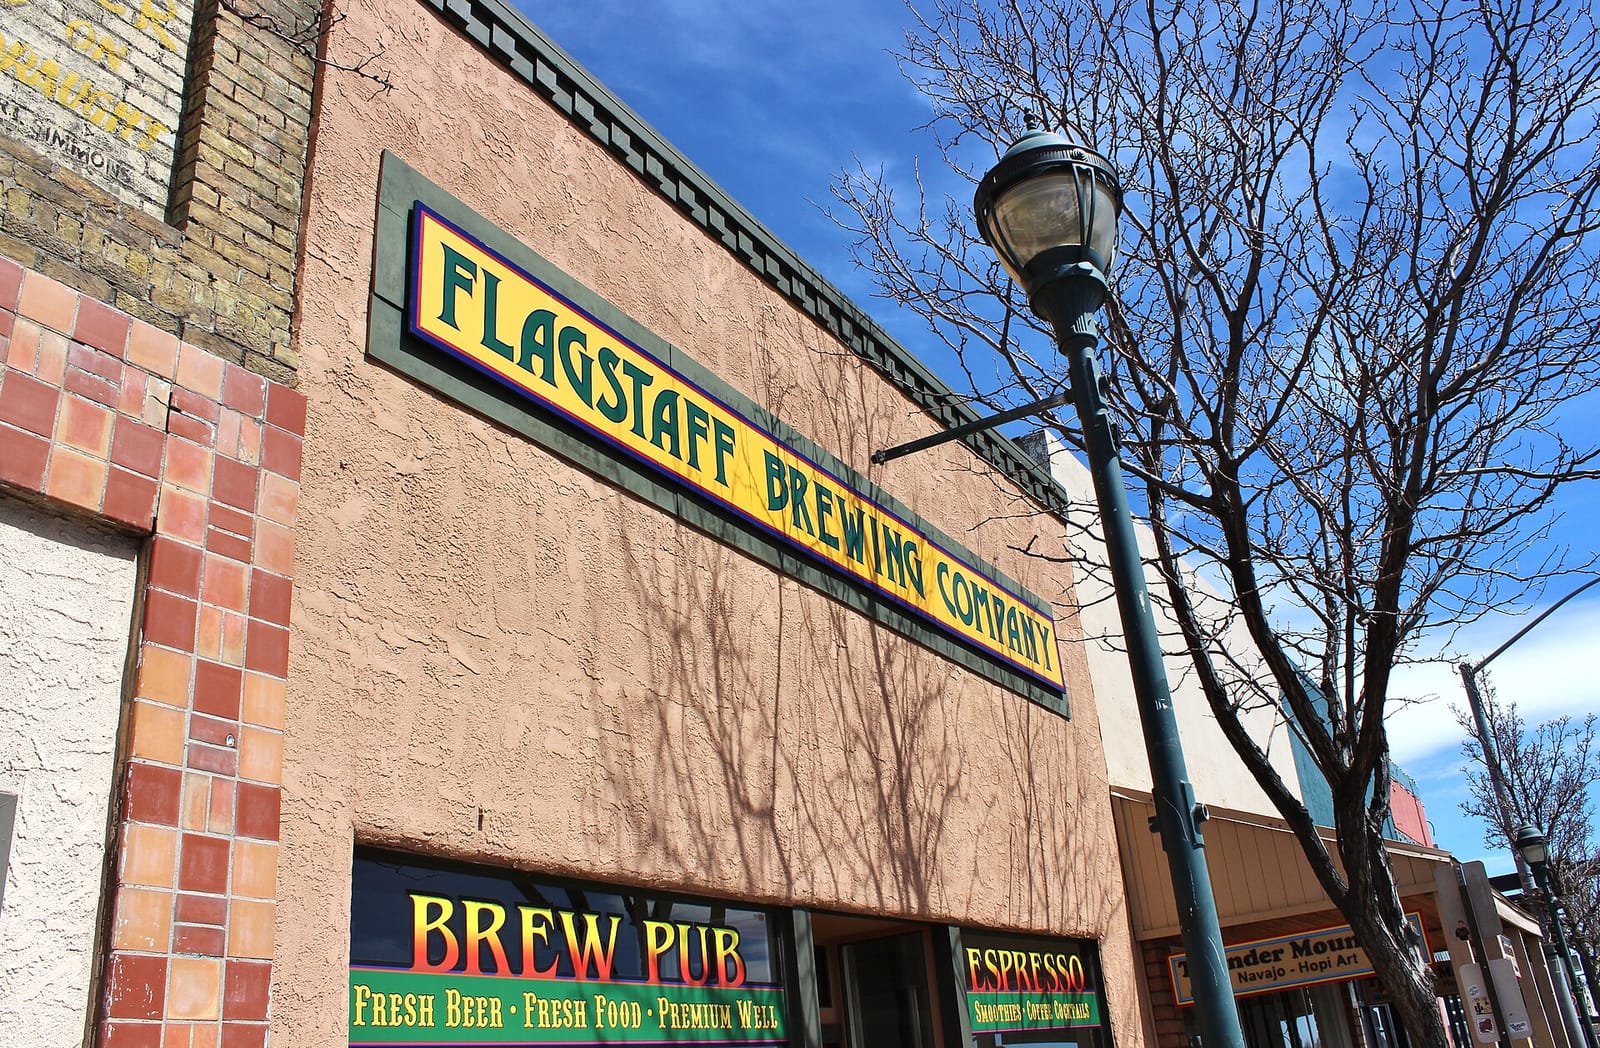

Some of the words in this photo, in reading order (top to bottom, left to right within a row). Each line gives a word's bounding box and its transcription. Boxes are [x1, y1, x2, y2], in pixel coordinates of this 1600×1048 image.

[437, 241, 736, 488] FLAGSTAFF
[763, 449, 926, 600] BREWING
[936, 561, 1052, 671] COMPANY
[409, 893, 622, 982] BREW
[643, 920, 747, 988] PUB
[966, 947, 1085, 992] ESPRESSO
[1178, 948, 1284, 979] Tnder
[1237, 966, 1286, 984] Navajo
[1298, 956, 1332, 974] Hopi
[1336, 952, 1359, 967] Art
[353, 984, 435, 1027] FRESH
[444, 988, 504, 1028] BEER
[522, 991, 587, 1028] FRESH
[594, 994, 642, 1029] FOOD
[657, 996, 733, 1030] PREMIUM
[736, 999, 779, 1030] WELL
[974, 1000, 1022, 1023] SMOOTHIES
